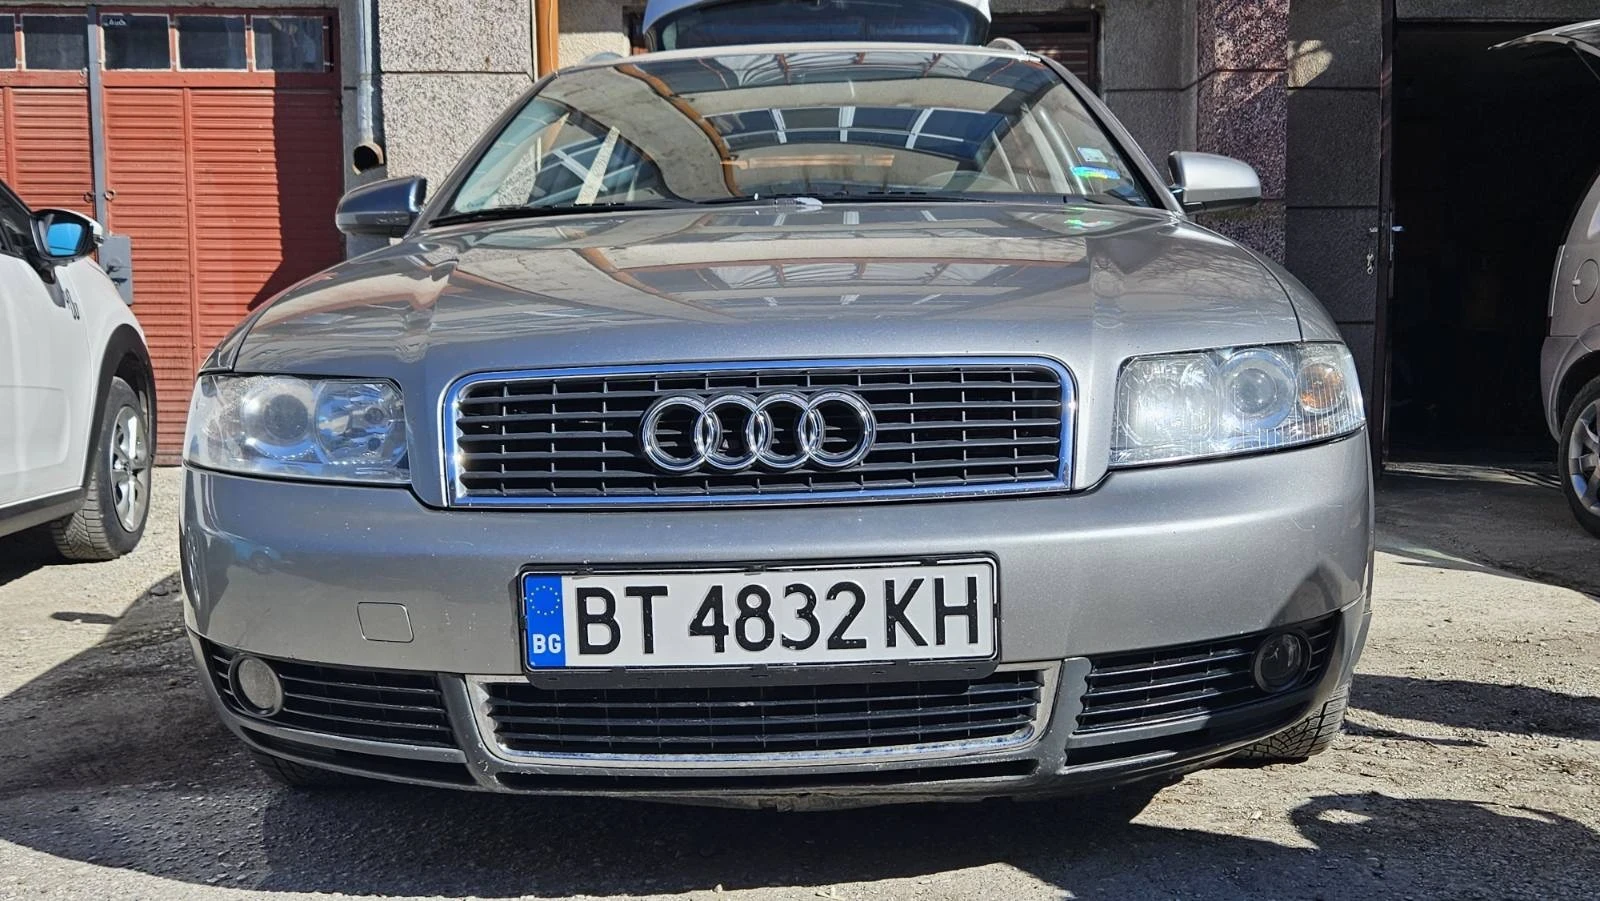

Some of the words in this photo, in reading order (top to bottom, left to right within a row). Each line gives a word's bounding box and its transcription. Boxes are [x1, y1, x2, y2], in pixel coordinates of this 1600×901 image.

[576, 585, 669, 655] BT
[689, 581, 867, 653] 4832
[885, 576, 978, 648] KH
[532, 633, 562, 654] BG
